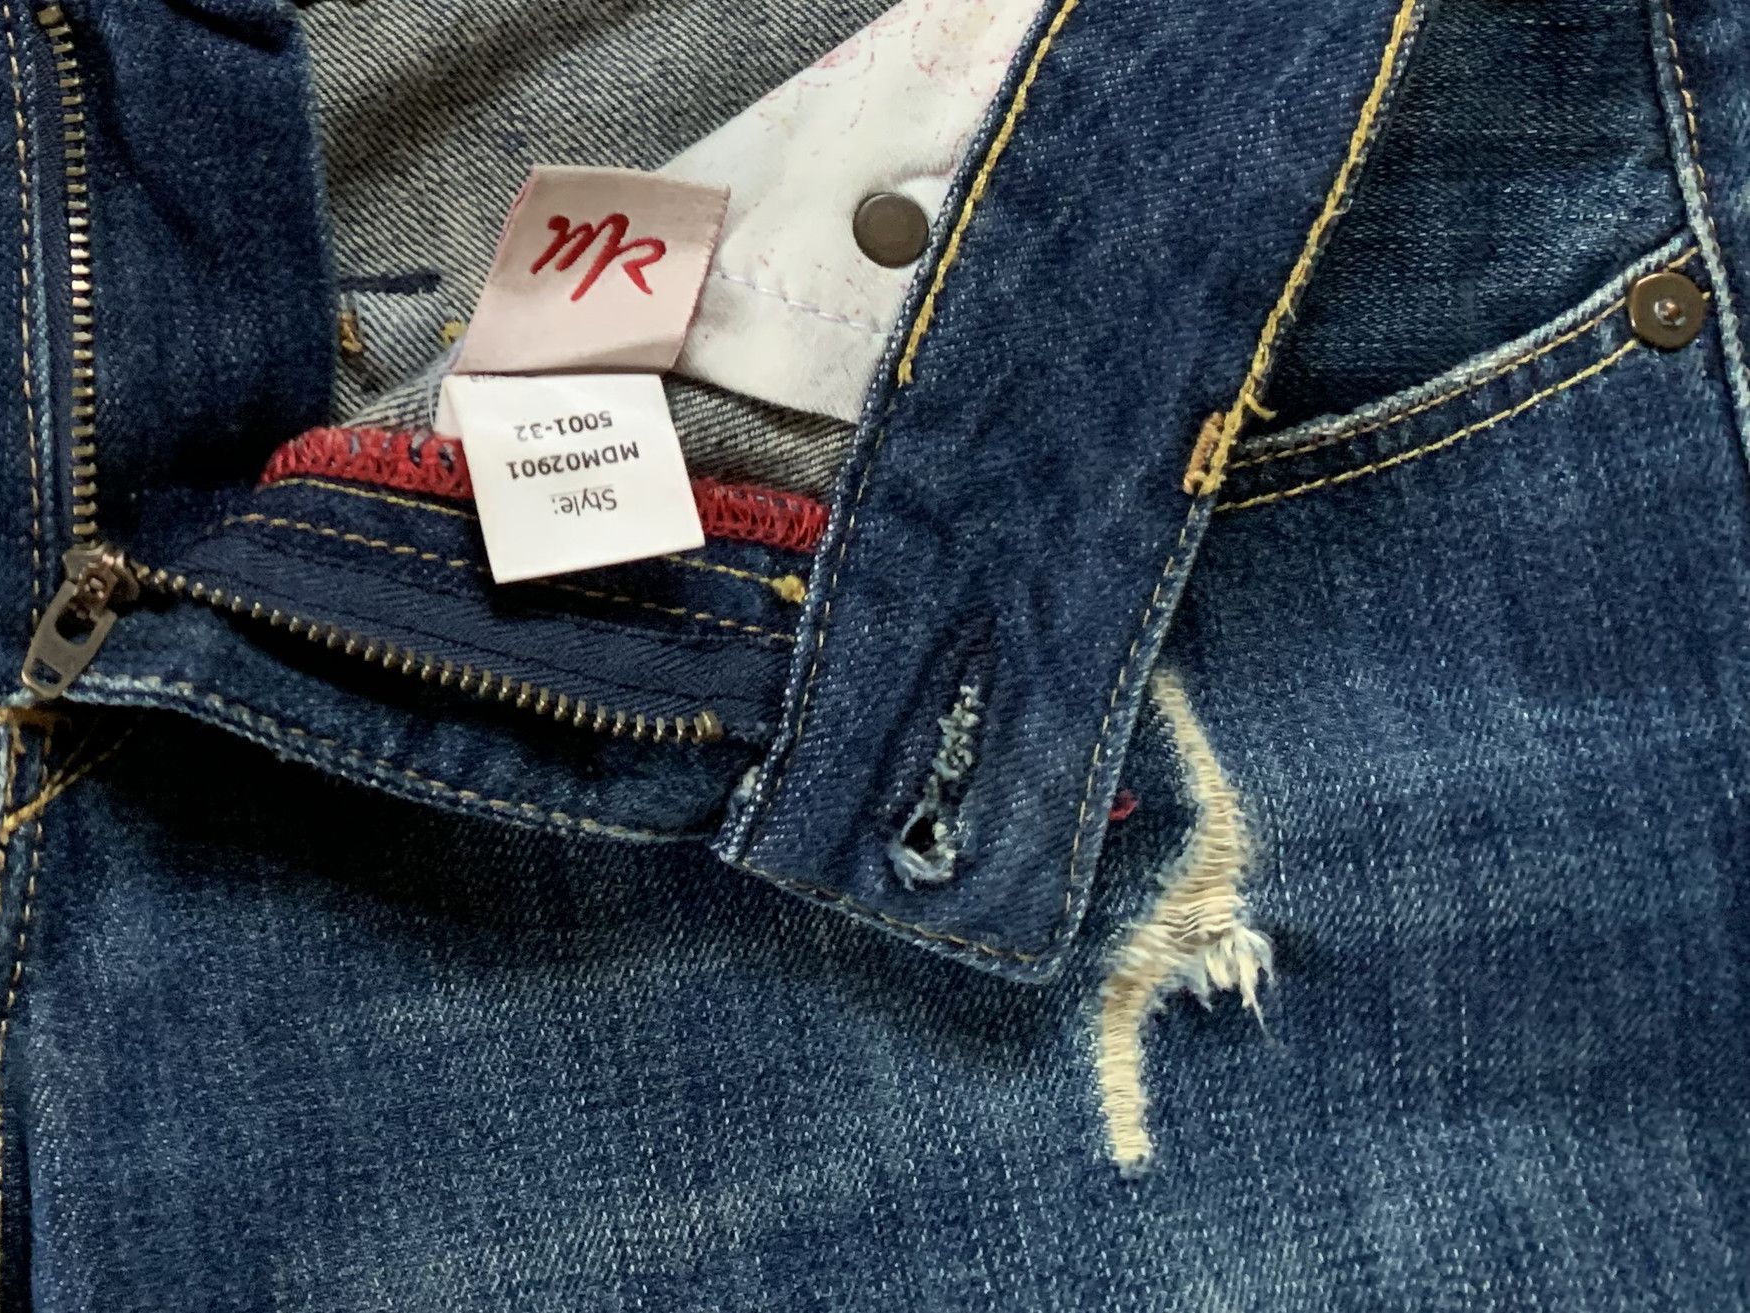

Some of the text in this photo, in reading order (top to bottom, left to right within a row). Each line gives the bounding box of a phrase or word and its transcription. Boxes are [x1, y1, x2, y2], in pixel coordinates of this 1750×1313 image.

[530, 213, 666, 301] MR
[514, 410, 613, 441] 5001-32
[506, 440, 639, 480] MDM02901
[552, 487, 618, 515] Style:
